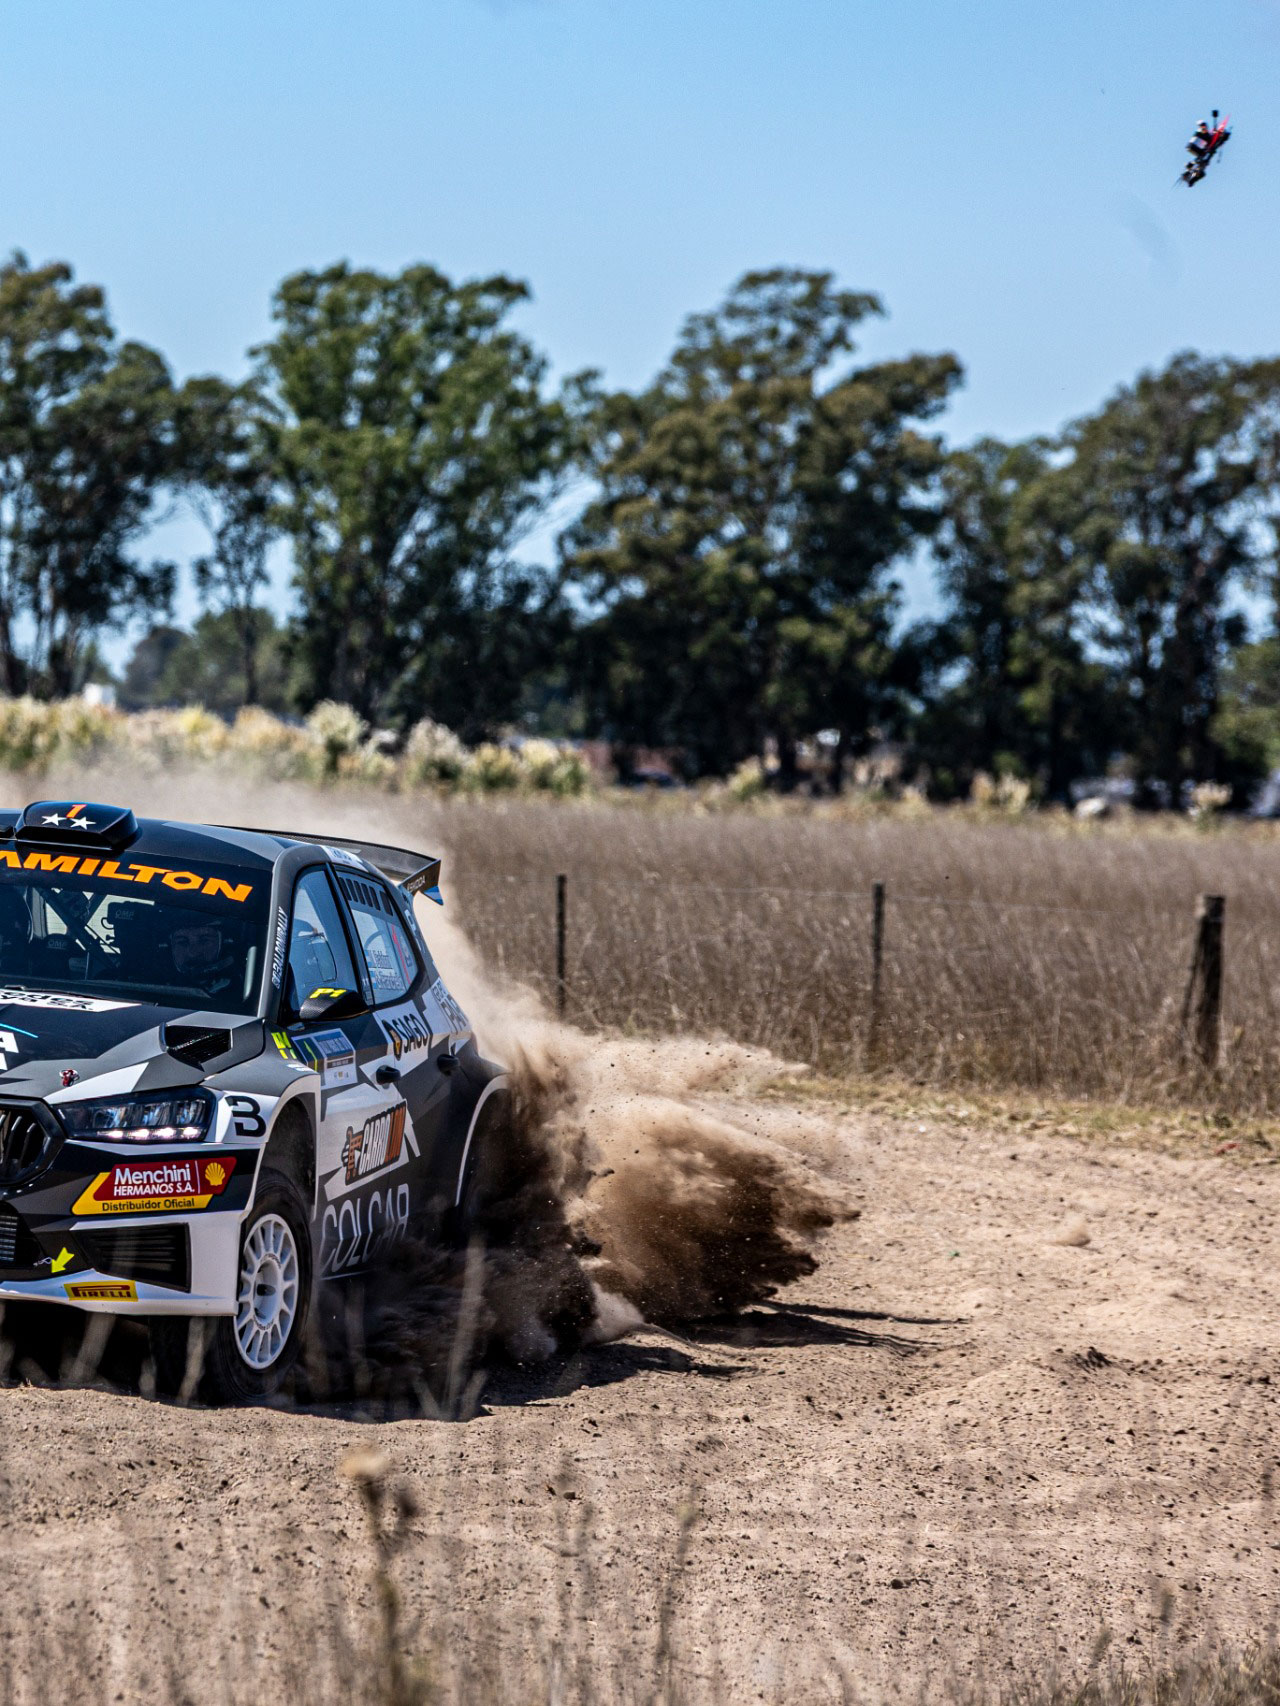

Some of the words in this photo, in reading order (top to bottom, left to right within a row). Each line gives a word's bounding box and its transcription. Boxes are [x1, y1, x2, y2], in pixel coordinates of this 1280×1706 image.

[66, 804, 87, 818] 1
[113, 1163, 191, 1185] Menchini
[113, 1183, 174, 1196] HERMANOS
[176, 1182, 195, 1194] S.A.
[102, 1200, 161, 1212] Distribuidor
[163, 1198, 195, 1209] Oficial
[71, 1285, 132, 1298] PIRELLI
